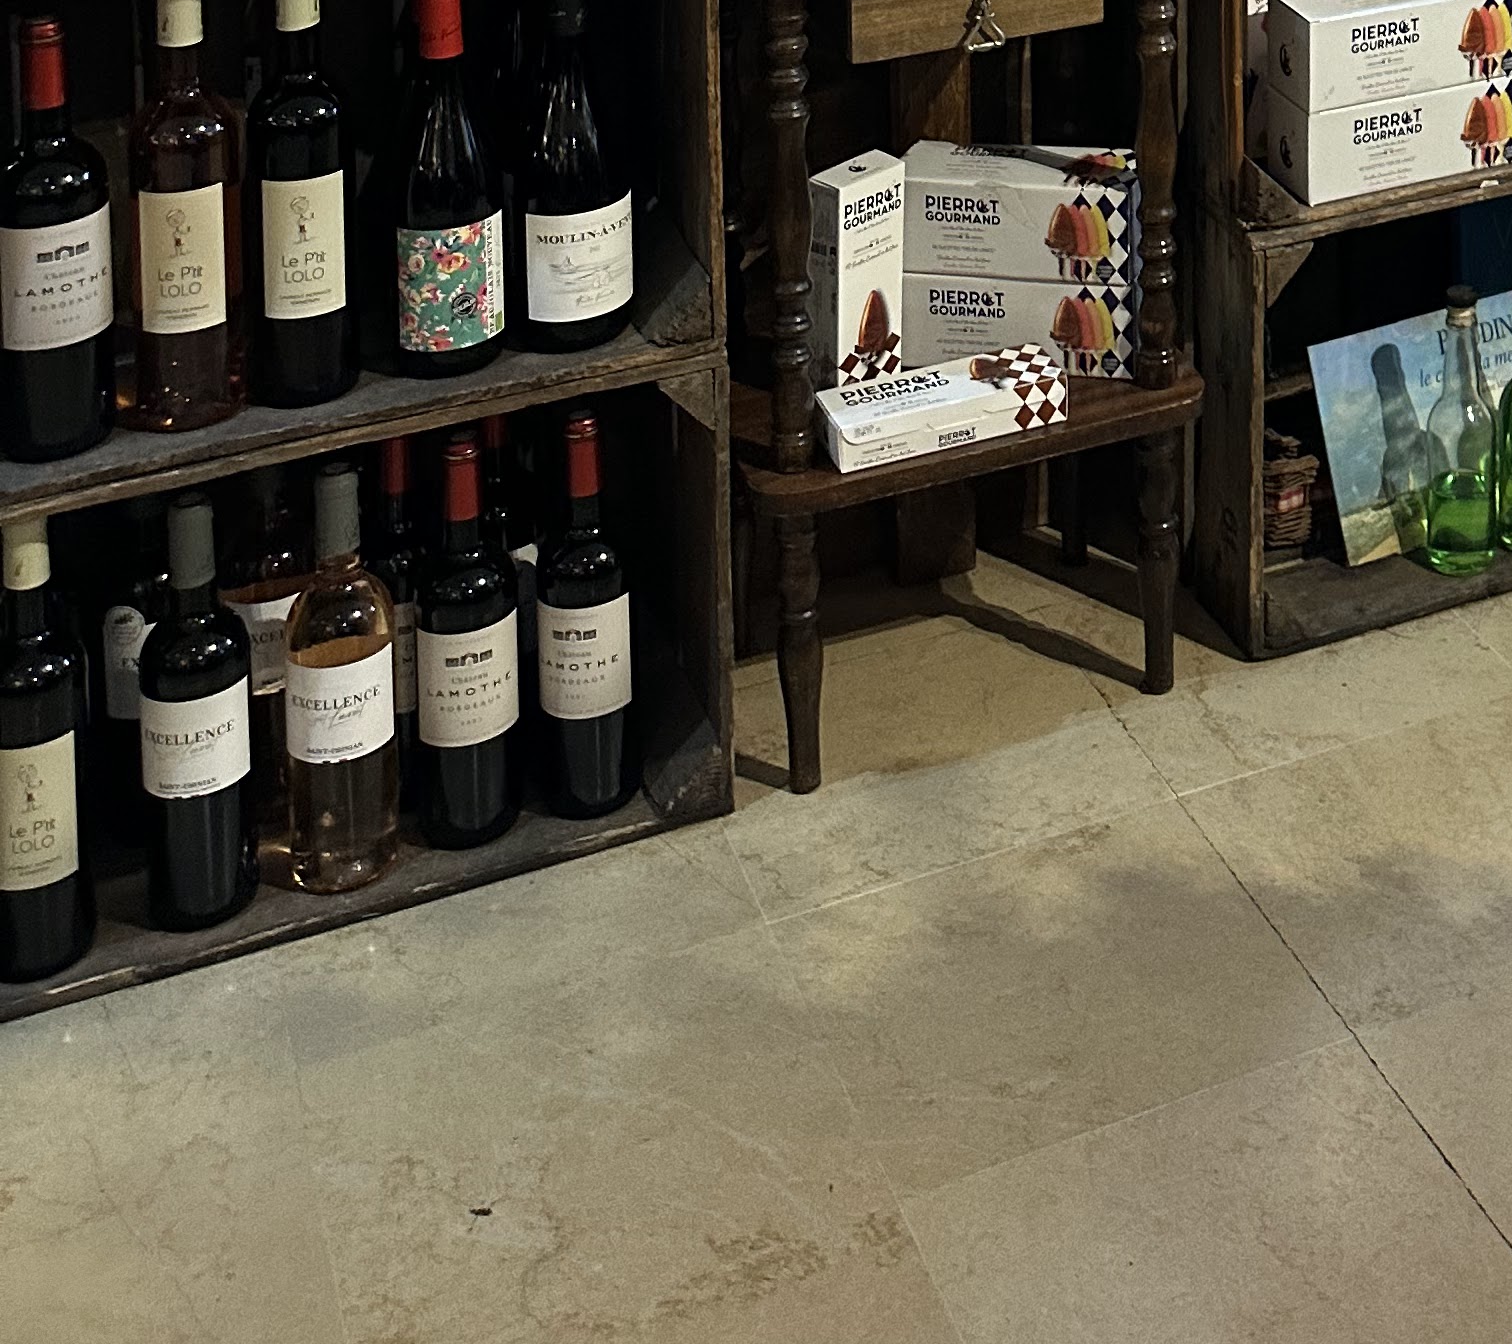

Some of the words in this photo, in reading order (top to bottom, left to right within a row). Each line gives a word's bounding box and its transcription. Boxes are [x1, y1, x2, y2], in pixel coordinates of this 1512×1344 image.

[1351, 17, 1420, 43] PIERROT
[1351, 32, 1420, 54] GOURMAND
[1353, 108, 1423, 135] PIERROT
[1353, 122, 1423, 146] GOURMAND
[844, 182, 902, 220] PIERROT
[925, 194, 1000, 214] PIERROT
[843, 198, 902, 231] GOURMAND
[925, 210, 1001, 226] GOURMAND
[281, 254, 299, 269] Le
[13, 265, 108, 298] LAMOTHE
[157, 267, 177, 283] Le
[283, 267, 325, 284] LOLO
[159, 281, 203, 299] LOLO
[929, 288, 1005, 307] PIERROT
[929, 304, 1006, 319] GOURMAND
[839, 370, 942, 401] PIERROT
[845, 379, 950, 407] GOURMAND
[426, 670, 513, 698] LAMOTHE
[292, 684, 381, 711] EXCELLENCE
[144, 719, 235, 746] EXCELLENCE
[8, 822, 28, 839] Le
[11, 834, 55, 855] LOLO
